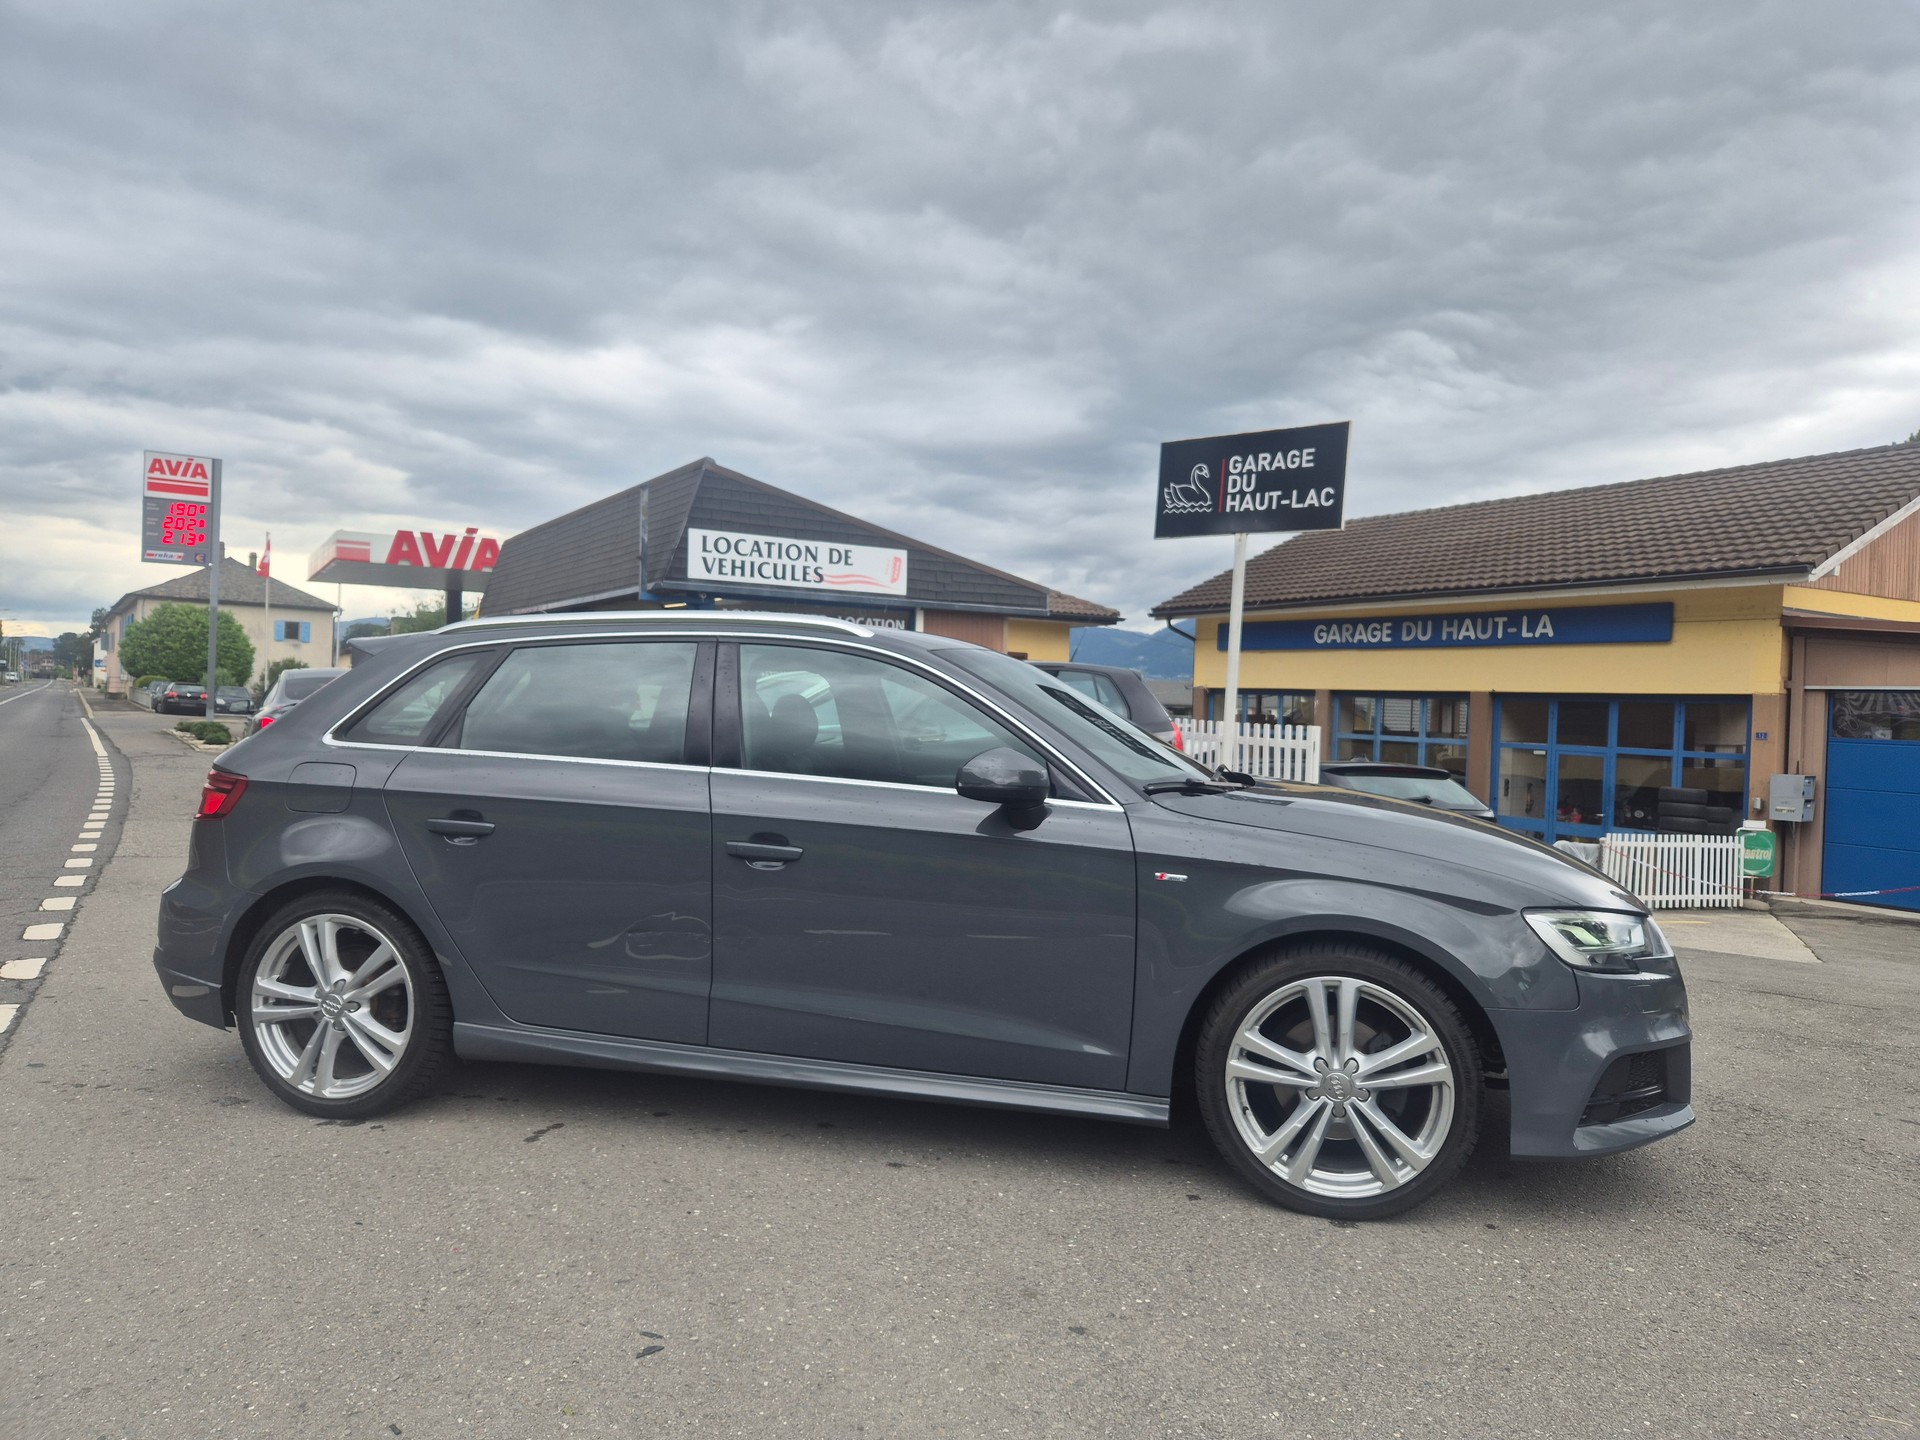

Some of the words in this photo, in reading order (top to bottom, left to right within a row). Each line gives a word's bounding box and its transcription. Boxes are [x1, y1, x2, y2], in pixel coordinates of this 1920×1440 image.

[1228, 448, 1316, 474] GARAGE
[1227, 473, 1257, 494] DU
[1225, 487, 1336, 513] HAUT-LAC
[702, 535, 819, 563] LOCATION
[828, 548, 853, 566] DE
[702, 556, 824, 583] VEHICULES
[1314, 622, 1392, 644] GARAGE
[1401, 620, 1432, 641] DU
[1441, 614, 1554, 641] HAUT-LA
[1742, 848, 1772, 861] astrol
